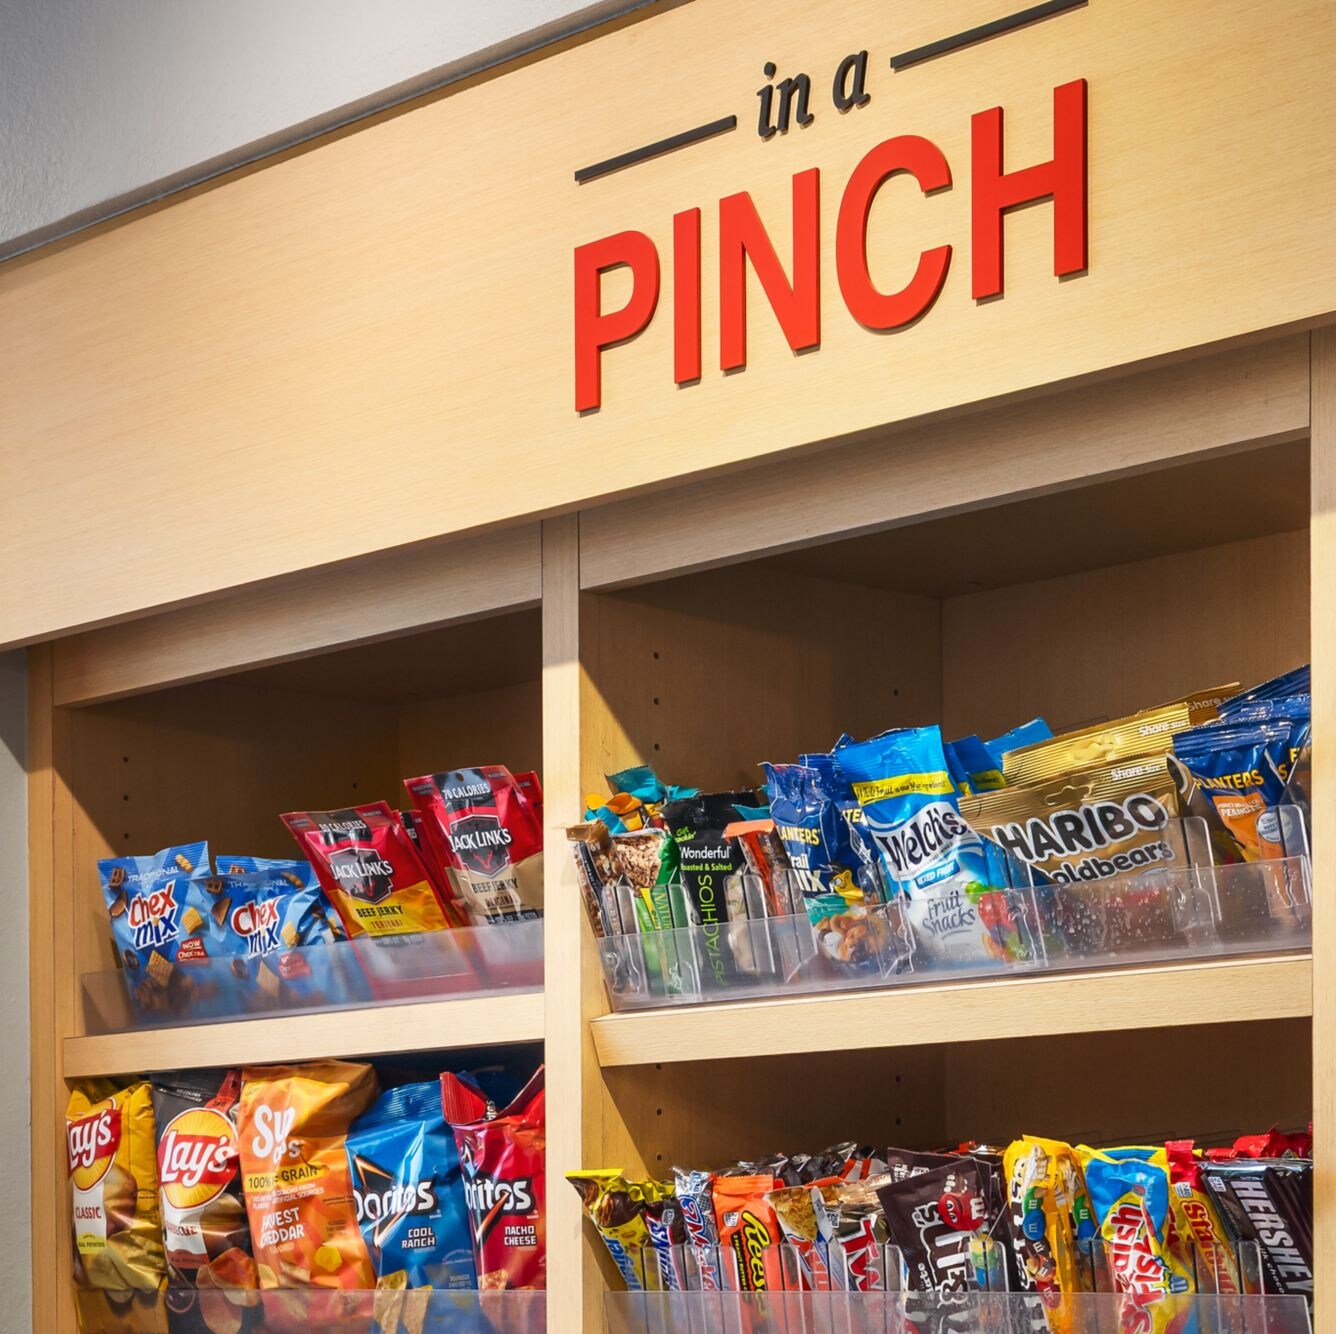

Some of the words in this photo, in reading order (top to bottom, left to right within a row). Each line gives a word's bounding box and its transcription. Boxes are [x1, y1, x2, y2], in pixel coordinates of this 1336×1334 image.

[756, 62, 815, 140] in
[832, 50, 871, 111] a
[573, 78, 1089, 413] PINCH
[1193, 769, 1264, 790] PLANTERS
[453, 783, 491, 799] CALORIES
[329, 820, 367, 833] CALORIES
[777, 826, 820, 846] LANTERS
[992, 794, 1168, 862] HARIBO
[448, 834, 475, 853] JACK
[475, 828, 512, 848] LINK'S
[876, 807, 968, 872] Welch's
[681, 846, 730, 859] Wonderful
[1052, 841, 1175, 884] oldbears
[330, 861, 355, 880] JACK
[355, 860, 393, 879] LINK'S
[711, 863, 732, 872] Salted
[472, 882, 492, 894] BEEF
[493, 878, 518, 892] JERKY
[129, 880, 178, 929] Chex
[356, 908, 375, 918] BEEF
[378, 905, 404, 917] JERKY
[926, 890, 962, 921] Fruit
[231, 894, 281, 937] Chex
[922, 907, 976, 937] Snacks
[135, 908, 179, 950] mix
[160, 1130, 232, 1187] Lay's
[281, 1166, 318, 1182] GRAIN
[464, 1180, 532, 1211] oritos
[75, 1206, 102, 1220] CLASSIC
[408, 1226, 434, 1237] COOL
[504, 1225, 535, 1236] NACHO
[504, 1235, 537, 1246] CHEESE
[401, 1237, 436, 1249] RANCH
